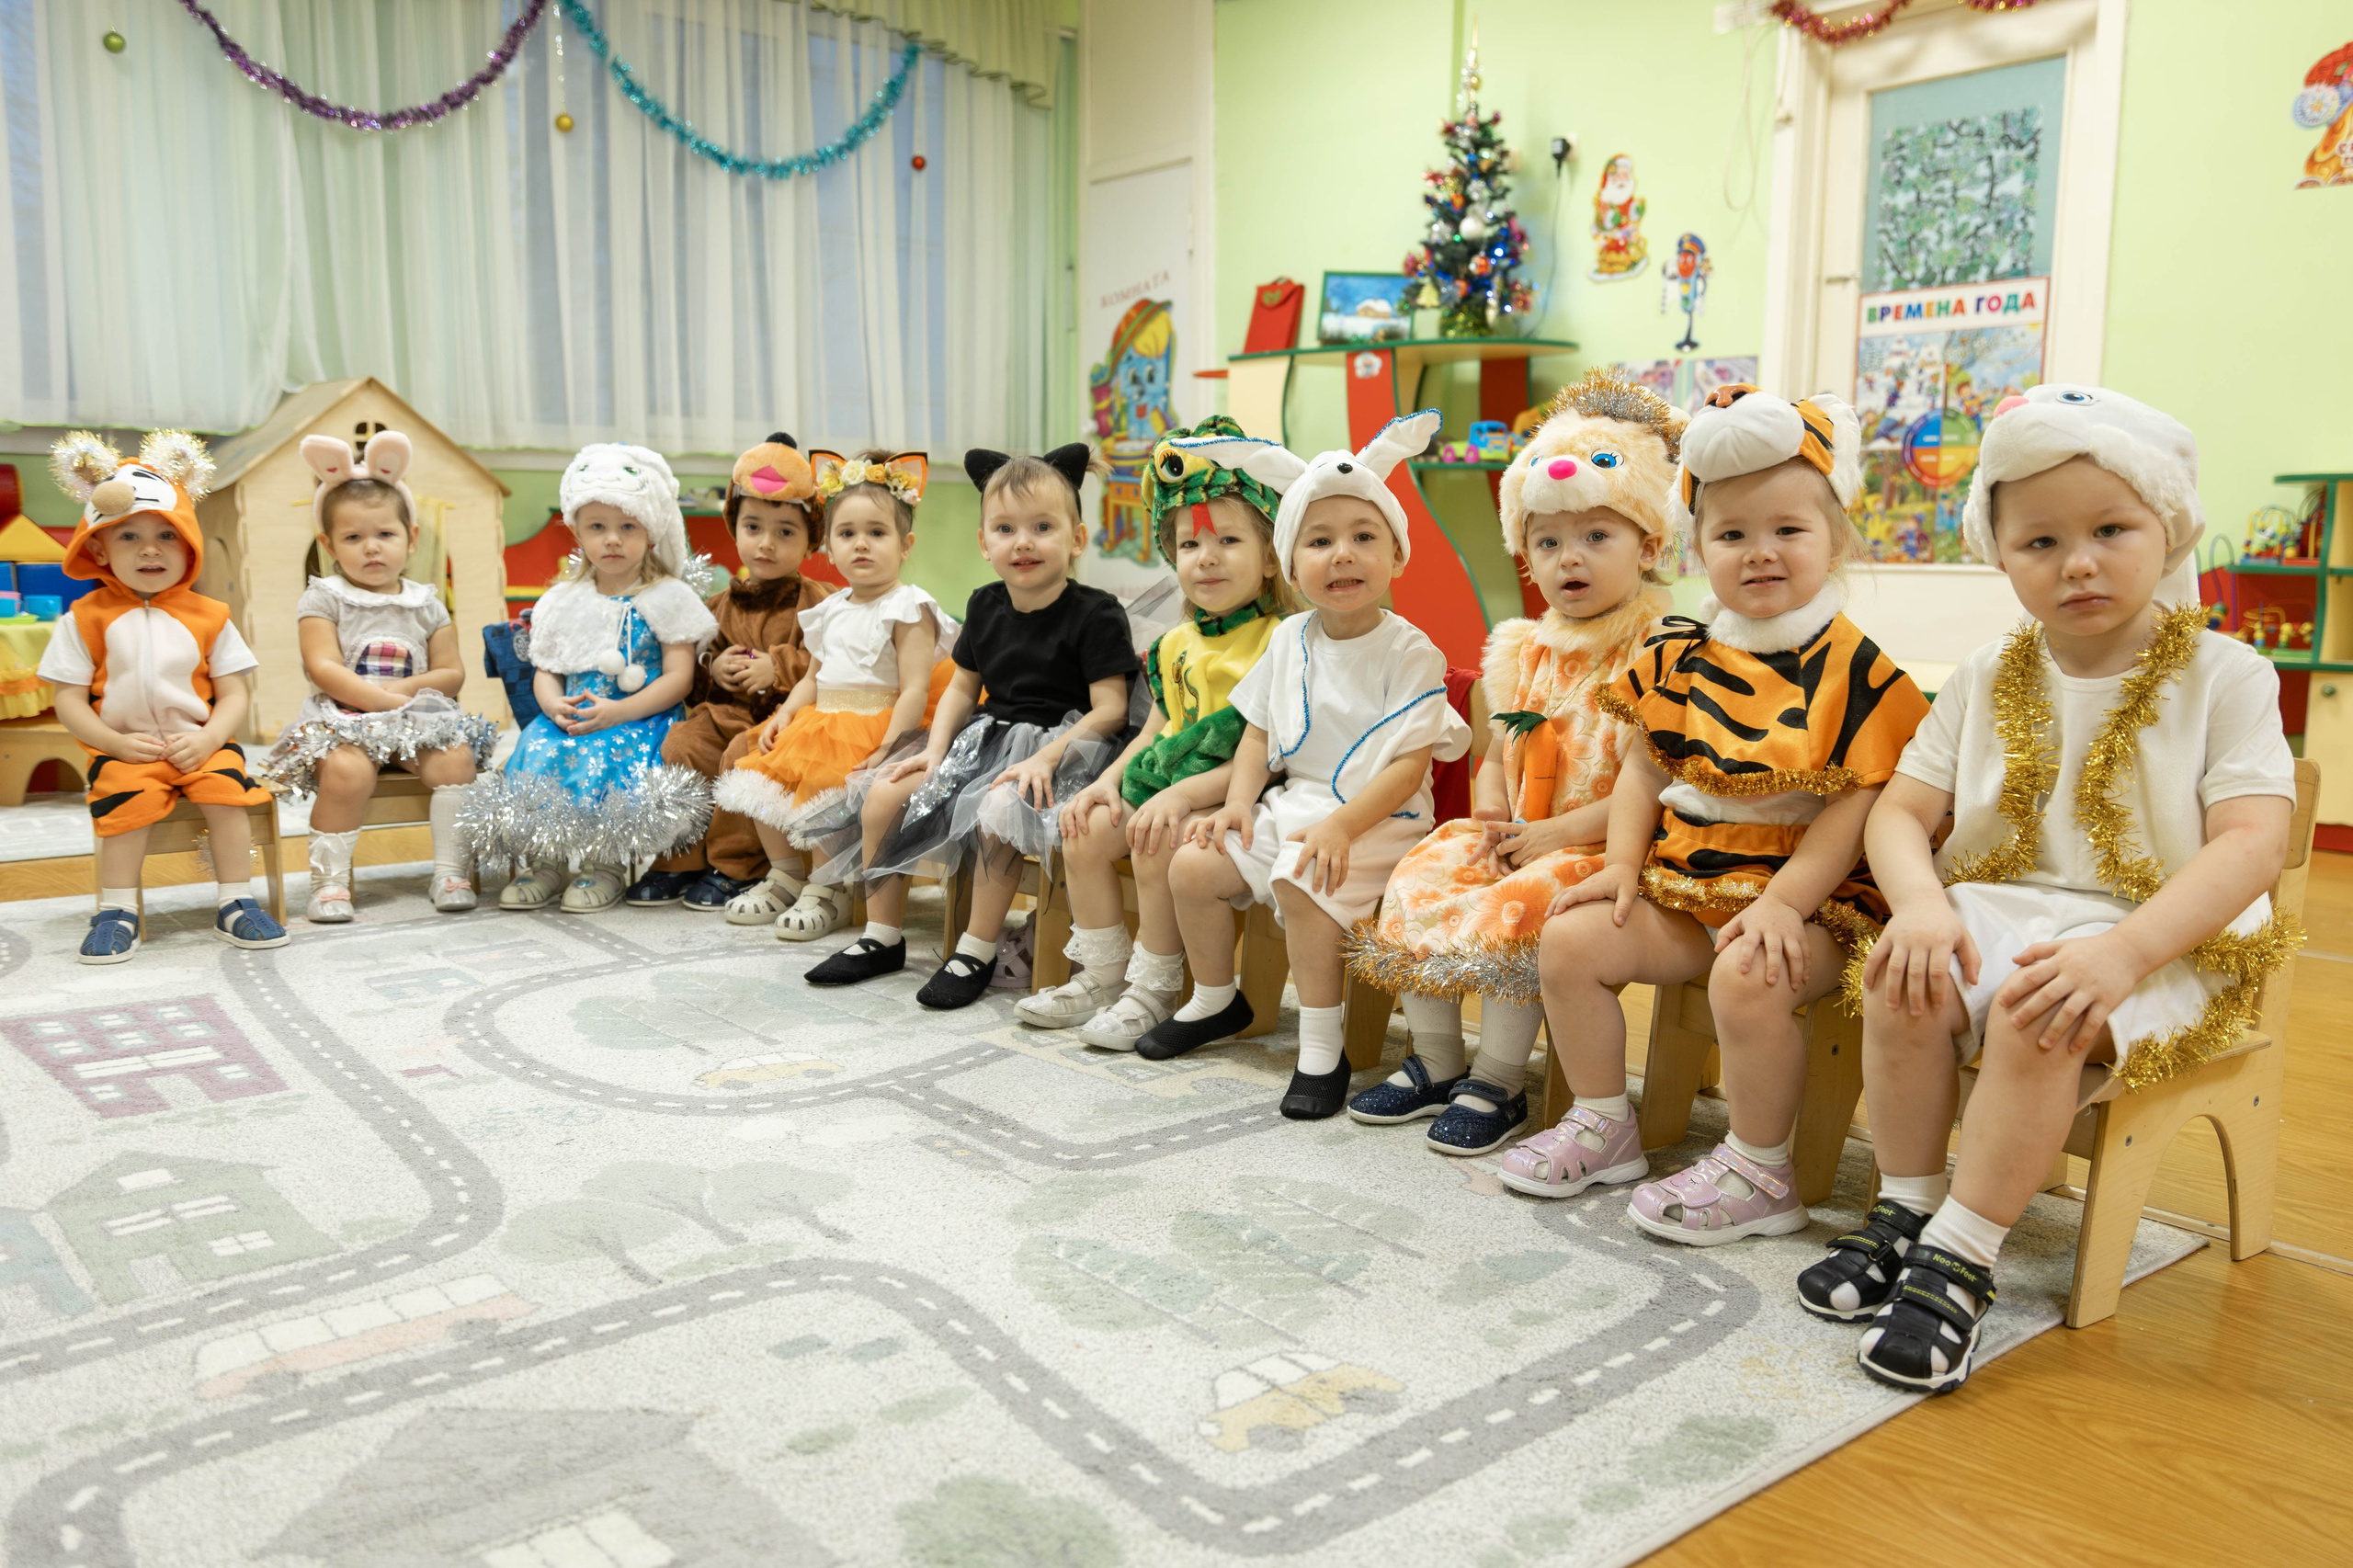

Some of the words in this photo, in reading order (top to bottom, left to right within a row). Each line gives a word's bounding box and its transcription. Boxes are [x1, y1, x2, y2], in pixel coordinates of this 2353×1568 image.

[1100, 269, 1170, 308] КОМНАТА
[1867, 298, 1966, 324] ВРЕМЕНА
[1976, 291, 2036, 314] ГОДА
[1960, 1267, 1977, 1282] Foot
